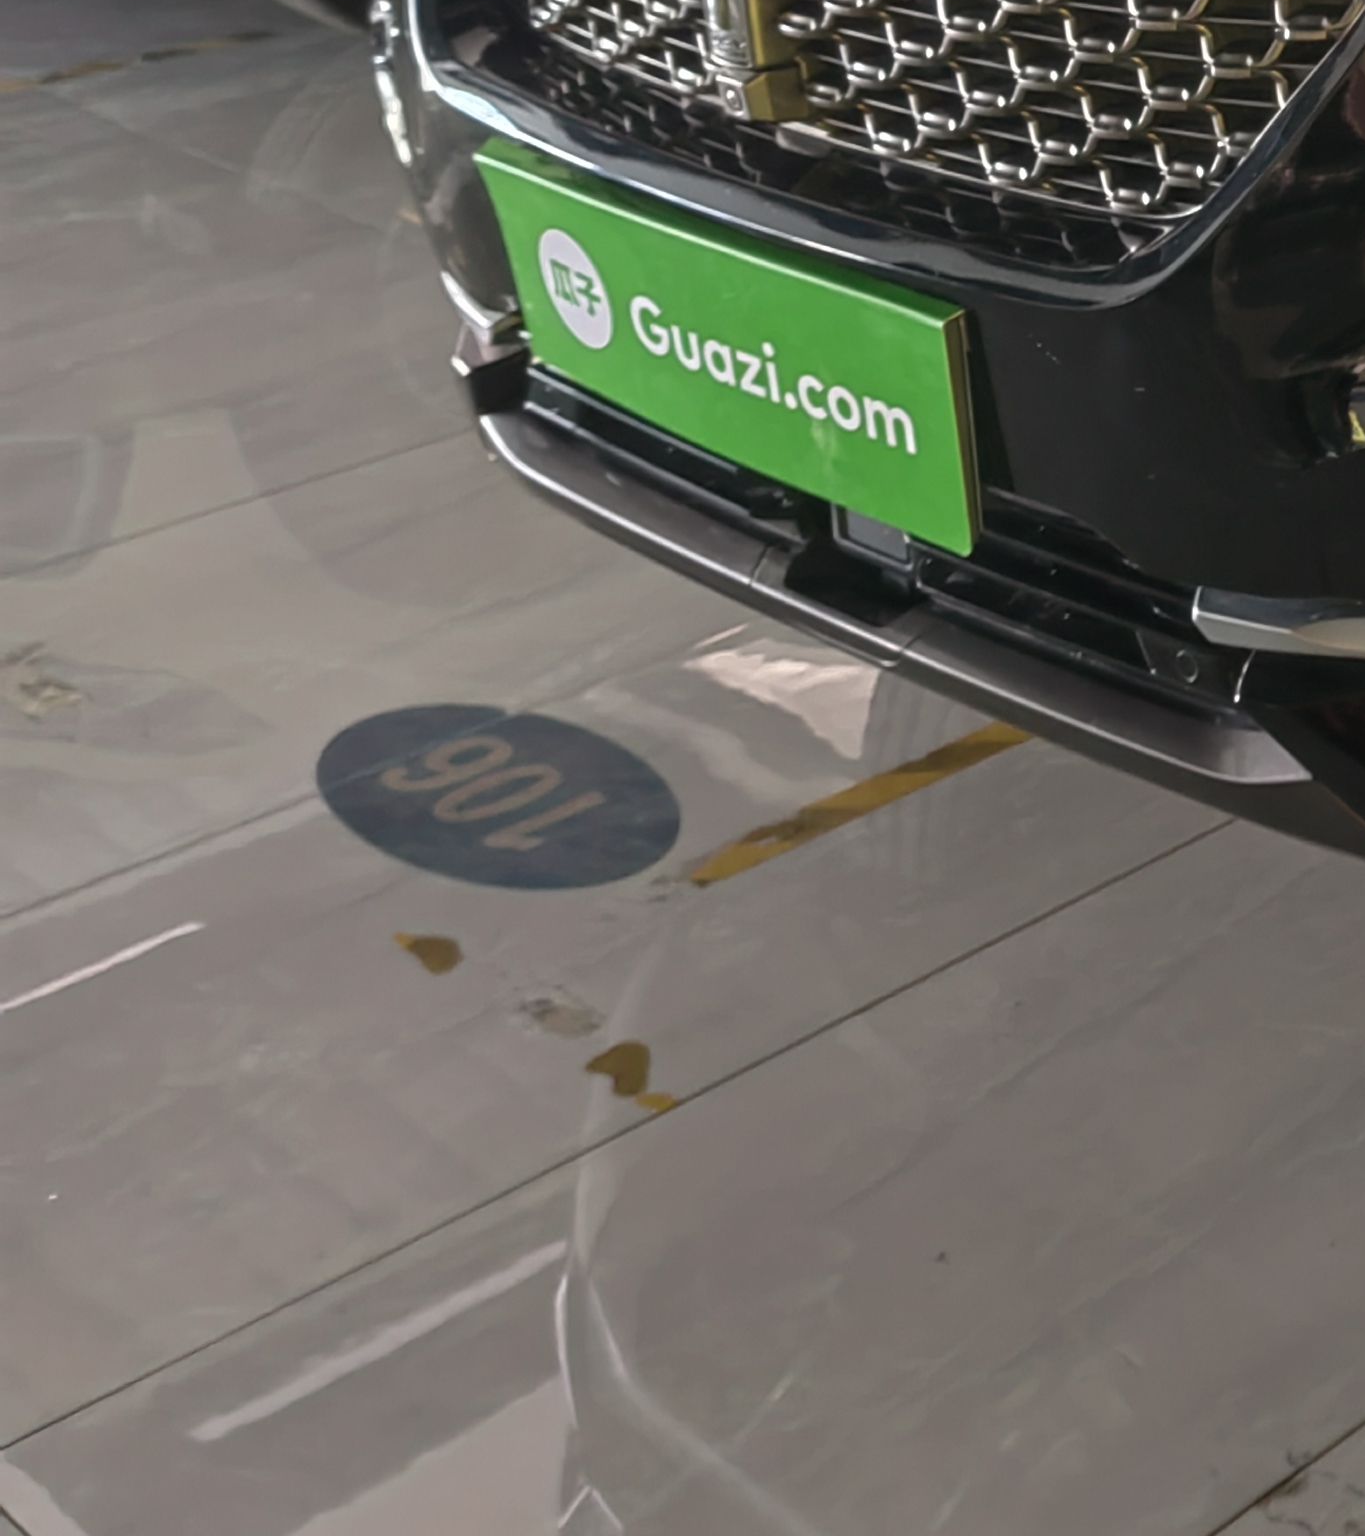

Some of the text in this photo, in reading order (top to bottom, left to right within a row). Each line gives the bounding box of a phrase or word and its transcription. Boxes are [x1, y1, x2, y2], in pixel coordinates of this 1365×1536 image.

[548, 258, 602, 317] 瓜子
[629, 295, 918, 456] Guazi.com
[380, 735, 607, 852] 106
